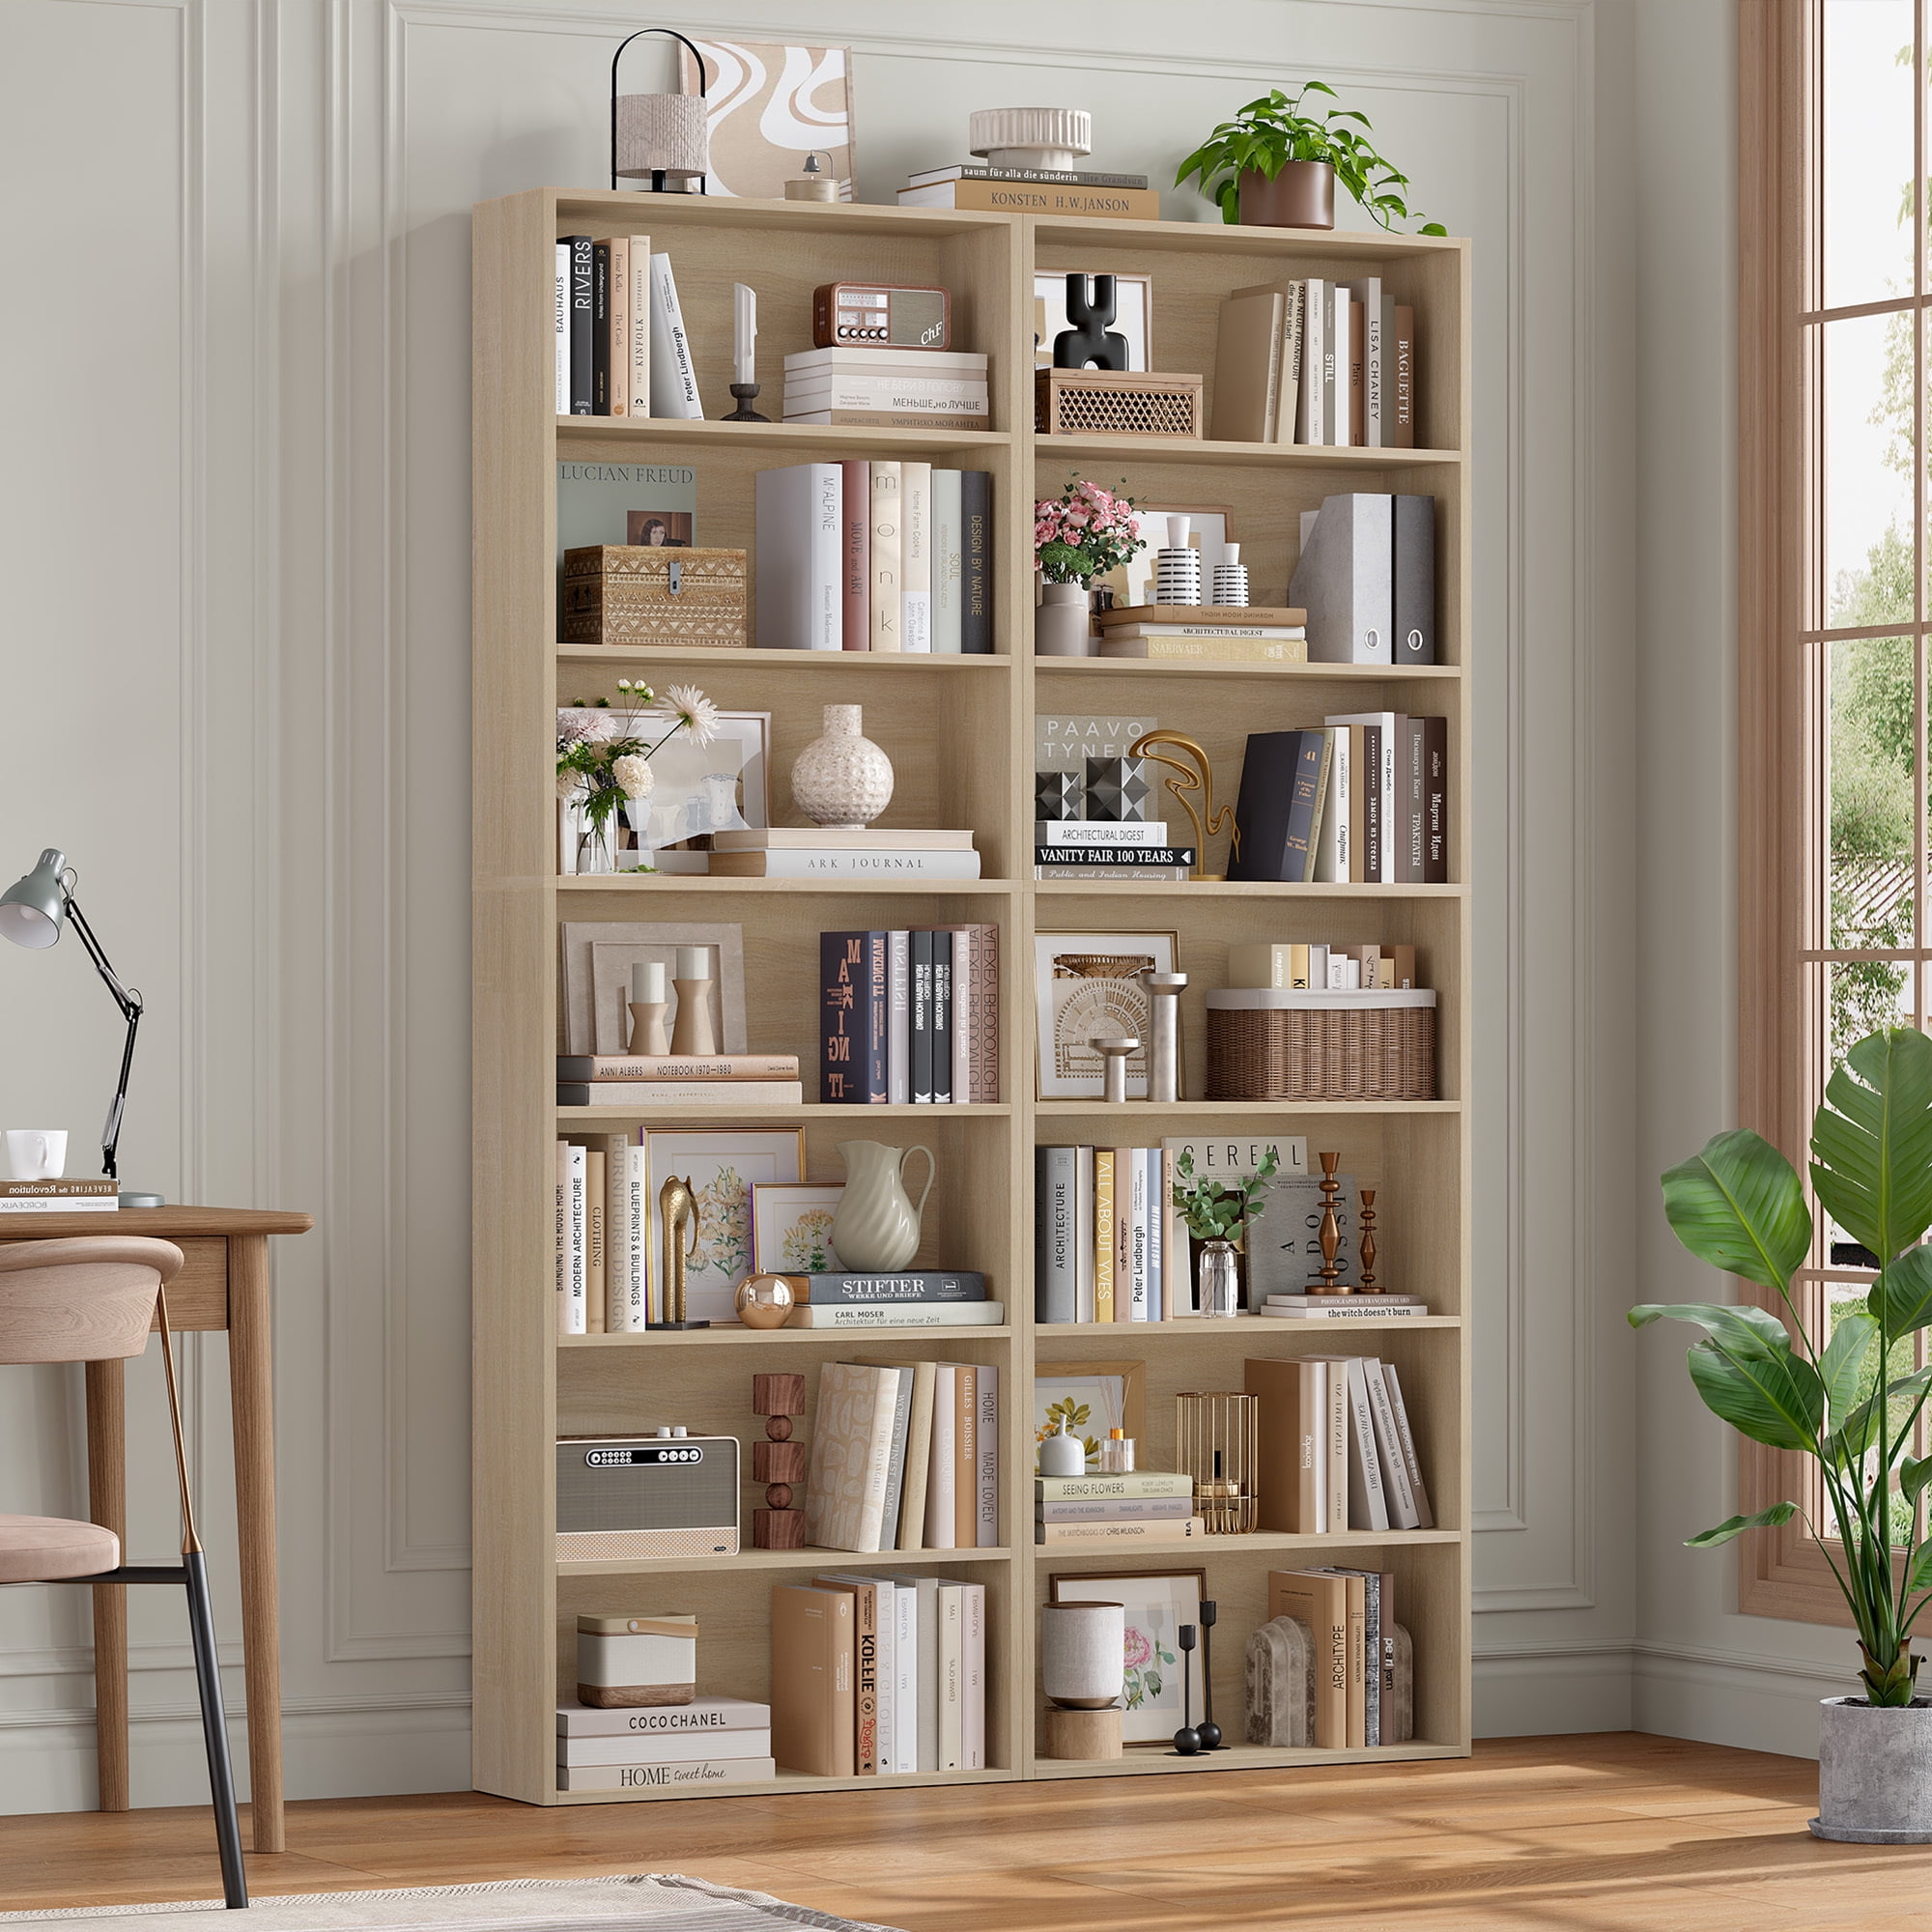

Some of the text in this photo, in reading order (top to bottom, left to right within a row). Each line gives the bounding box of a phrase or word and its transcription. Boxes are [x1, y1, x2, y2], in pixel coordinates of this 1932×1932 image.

[963, 167, 1078, 182] saum für alla die sünderin
[991, 192, 1130, 212] KONSTEN H.W.JANSON
[575, 241, 591, 310] RIVERS
[555, 276, 564, 333] BAUHAUS
[1295, 305, 1304, 328] NEUE
[636, 318, 644, 367] KINFOLK
[1292, 330, 1302, 381] FRANKFURT
[672, 327, 695, 402] Peter Lindbergh
[1324, 354, 1334, 383] STILL
[1370, 321, 1379, 420] LISA CHANEY
[1398, 339, 1409, 425] BAGUETTE
[948, 400, 980, 411] ЛУЧШЕ
[561, 465, 694, 484] LUCIAN FREUD
[850, 522, 864, 554] MOVE
[911, 530, 922, 559] Cooking
[949, 553, 960, 581] SOUL
[971, 515, 982, 616] DESIGN BY NATURE
[850, 574, 864, 597] ART
[1046, 721, 1144, 738] PAAVO
[1304, 751, 1317, 762] 41
[1412, 733, 1421, 800] Иммануил Кант
[1062, 829, 1145, 841] ARCHITECTURAL DIGEST
[1370, 827, 1377, 838] из
[1412, 812, 1421, 867] ТРАКТАТЫ
[1431, 792, 1442, 861] Мартин Иден
[808, 857, 924, 869] ARK JOURNAL
[1039, 848, 1175, 864] VANITY FAIR 100 YEARS
[1048, 868, 1167, 881] Public and Indian Housing
[1274, 951, 1284, 988] simplicity
[599, 1065, 644, 1077] ANNI ALBERS
[656, 1065, 695, 1076] NOTEBOOK
[573, 1177, 582, 1253] ARCHITECTURE
[631, 1181, 640, 1242] BLUEPRINTS
[1055, 1182, 1065, 1269] ARCHITECTURE
[592, 1207, 602, 1267] CLOTHING
[612, 1138, 625, 1332] FURNITURE DESIGN
[1097, 1159, 1111, 1300] ALL ABOUT YVES
[573, 1254, 582, 1297] MODERN
[630, 1253, 640, 1306] BUILDINGS
[1133, 1225, 1145, 1303] Peter Lindbergh
[841, 1278, 925, 1294] STIFTER
[1327, 1309, 1341, 1318] the
[1392, 1307, 1411, 1316] burn
[964, 1375, 973, 1461] GILLES BOISSIER
[884, 1394, 905, 1518] WORLD'S FINEST HOMES
[981, 1392, 995, 1524] HOME MADE LOVELY
[1062, 1483, 1090, 1495] SEEING
[1091, 1482, 1125, 1494] FLOWERS
[1106, 1526, 1145, 1536] CHRIS WILKINSON
[1332, 1625, 1345, 1690] ARCHITYPE
[1382, 1637, 1394, 1667] pearl
[628, 1713, 726, 1729] COCO CHANEL
[620, 1763, 726, 1787] HOME sweet home
